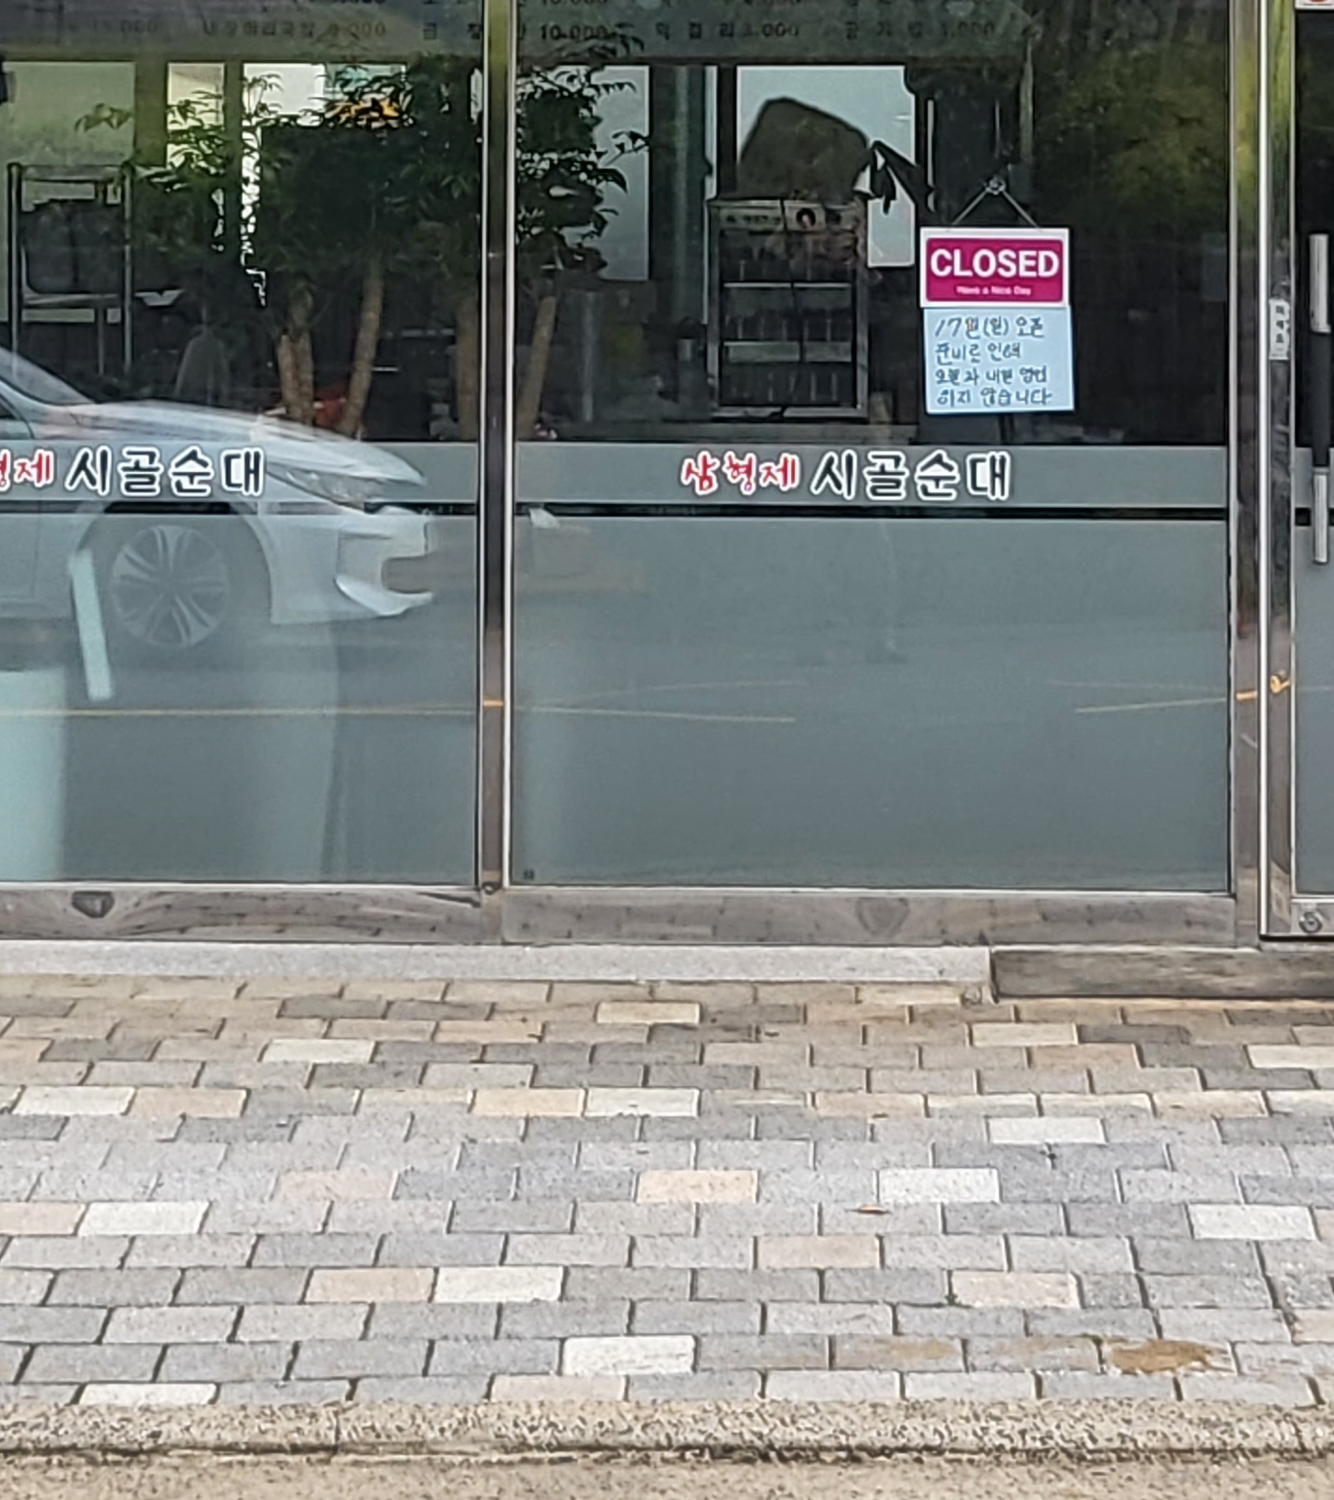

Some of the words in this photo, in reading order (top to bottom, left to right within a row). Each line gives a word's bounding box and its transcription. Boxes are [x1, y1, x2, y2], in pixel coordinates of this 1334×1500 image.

[930, 248, 1060, 278] CLOSED
[65, 445, 264, 497] 시골순대
[681, 451, 800, 495] 삼형제
[810, 449, 1010, 500] 시골순대
